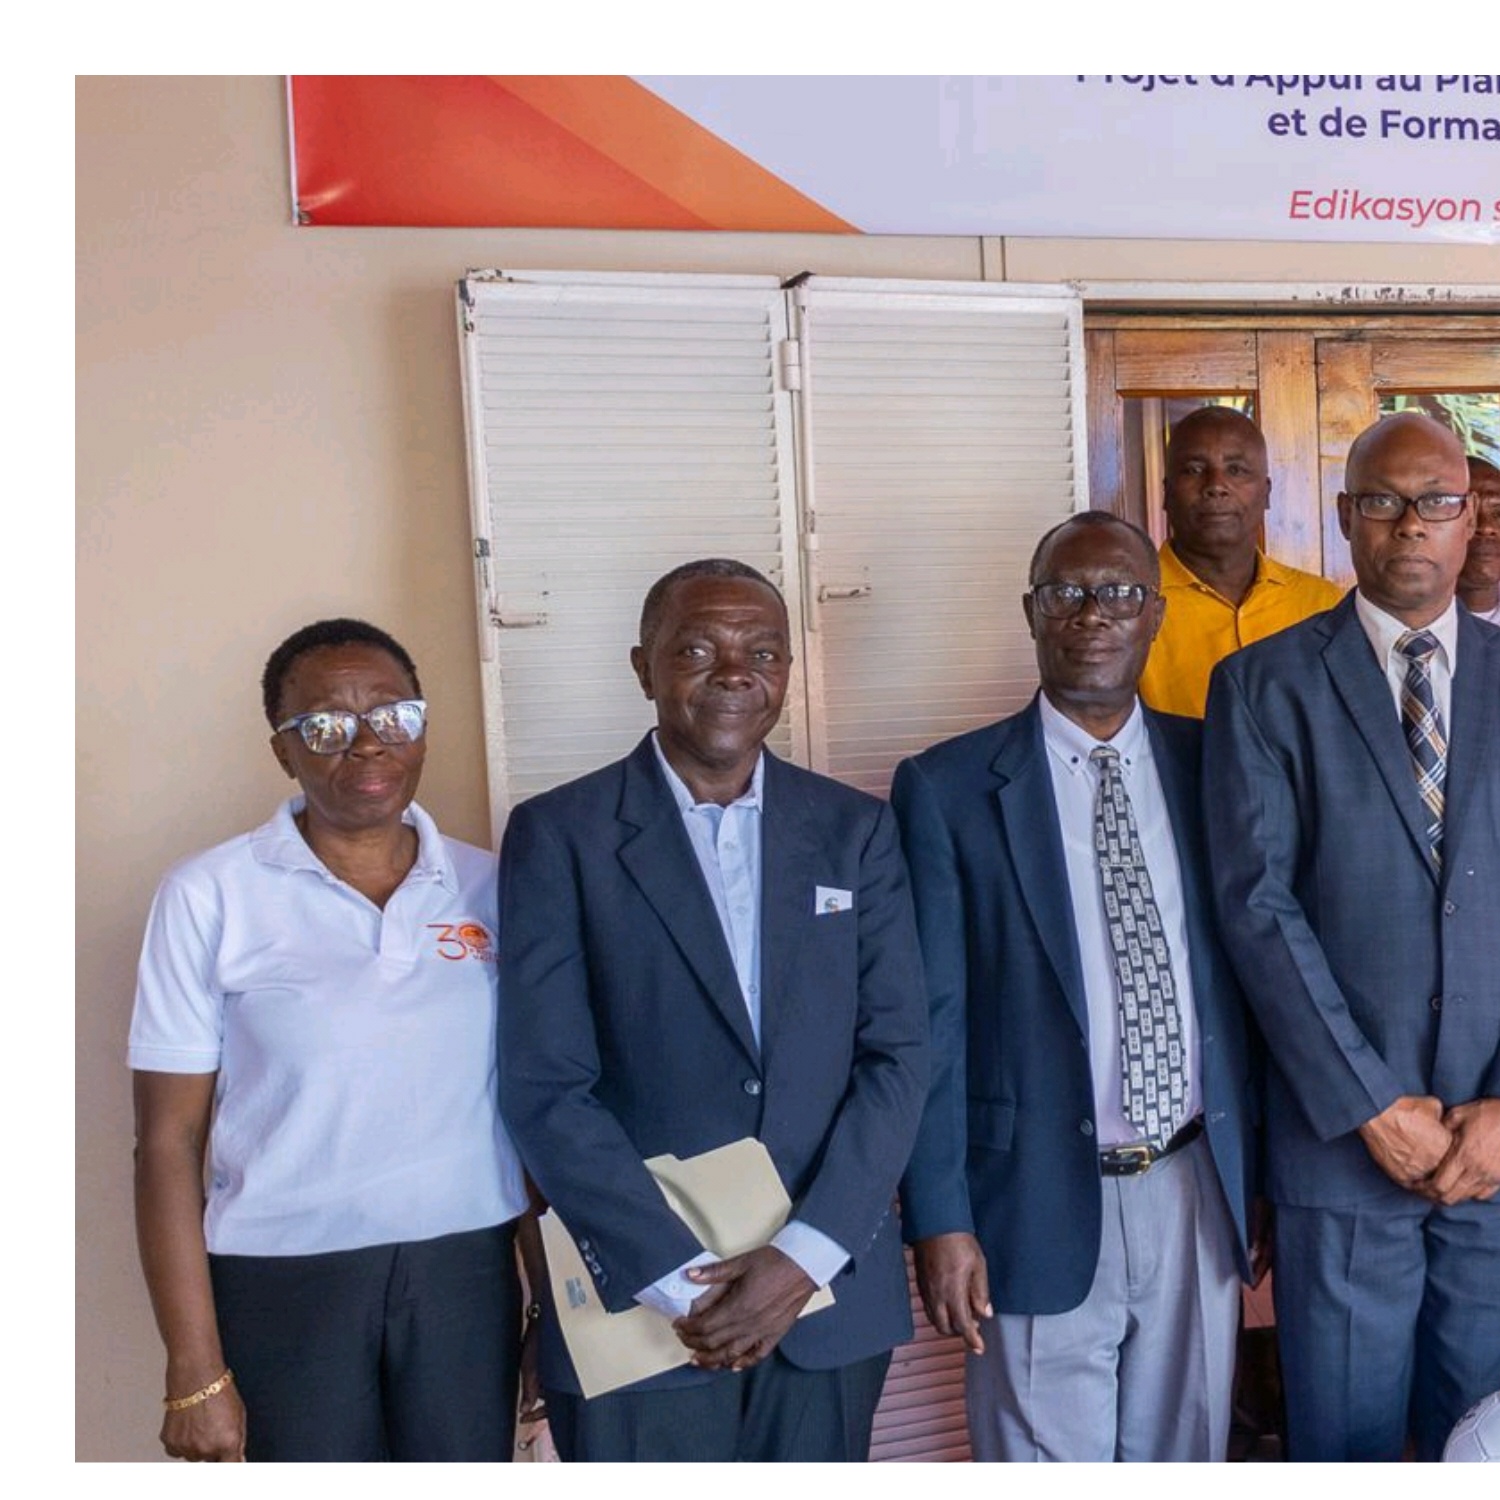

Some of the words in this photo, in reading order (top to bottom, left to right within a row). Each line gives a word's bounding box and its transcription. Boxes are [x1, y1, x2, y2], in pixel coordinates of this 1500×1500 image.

[1267, 109, 1307, 137] et
[1319, 107, 1367, 138] de
[1289, 190, 1482, 228] Edikasyon
